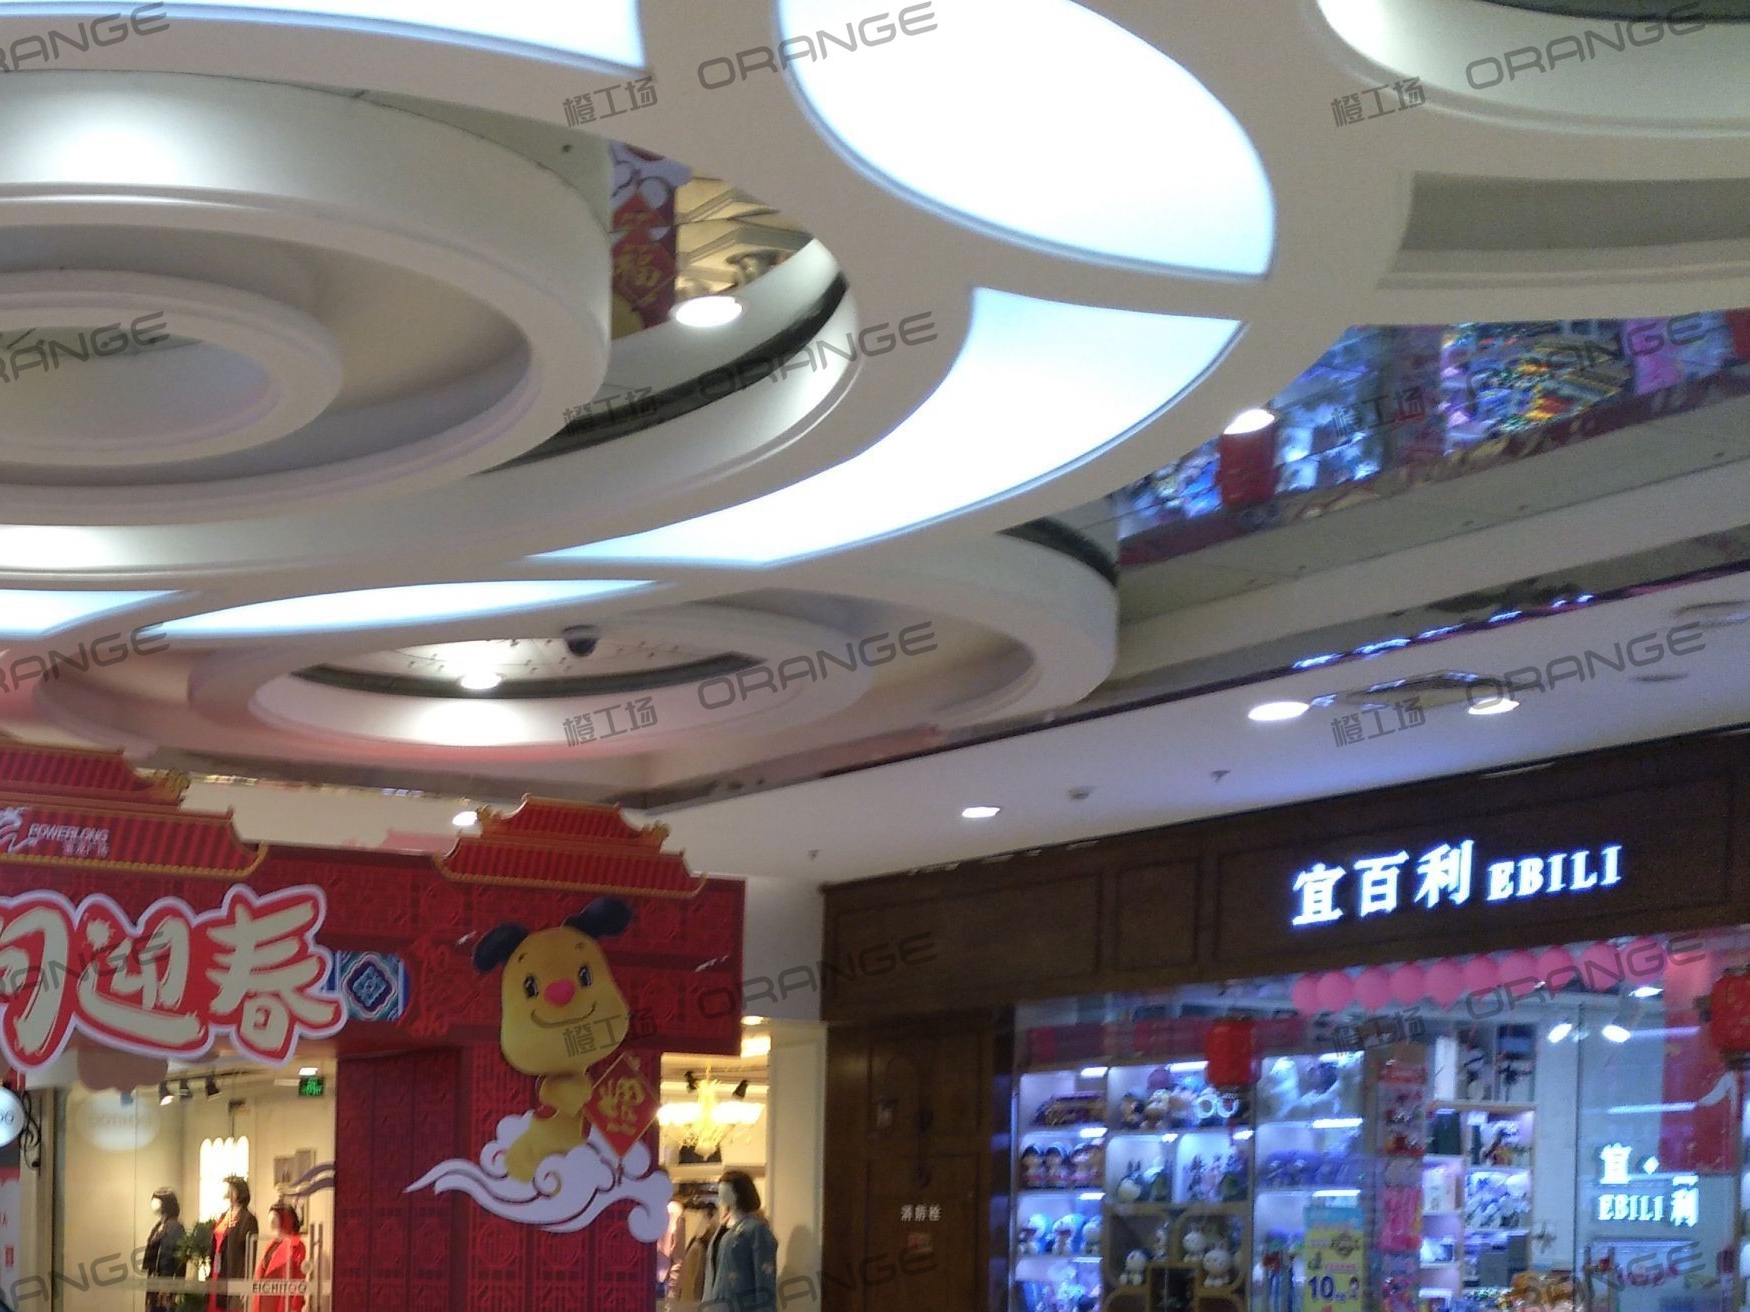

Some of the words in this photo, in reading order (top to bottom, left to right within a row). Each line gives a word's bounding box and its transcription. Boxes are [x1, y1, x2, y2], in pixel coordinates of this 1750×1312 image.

[1292, 840, 1475, 926] 宜百利
[1486, 845, 1623, 901] EBILI
[1598, 1193, 1665, 1222] EBILI
